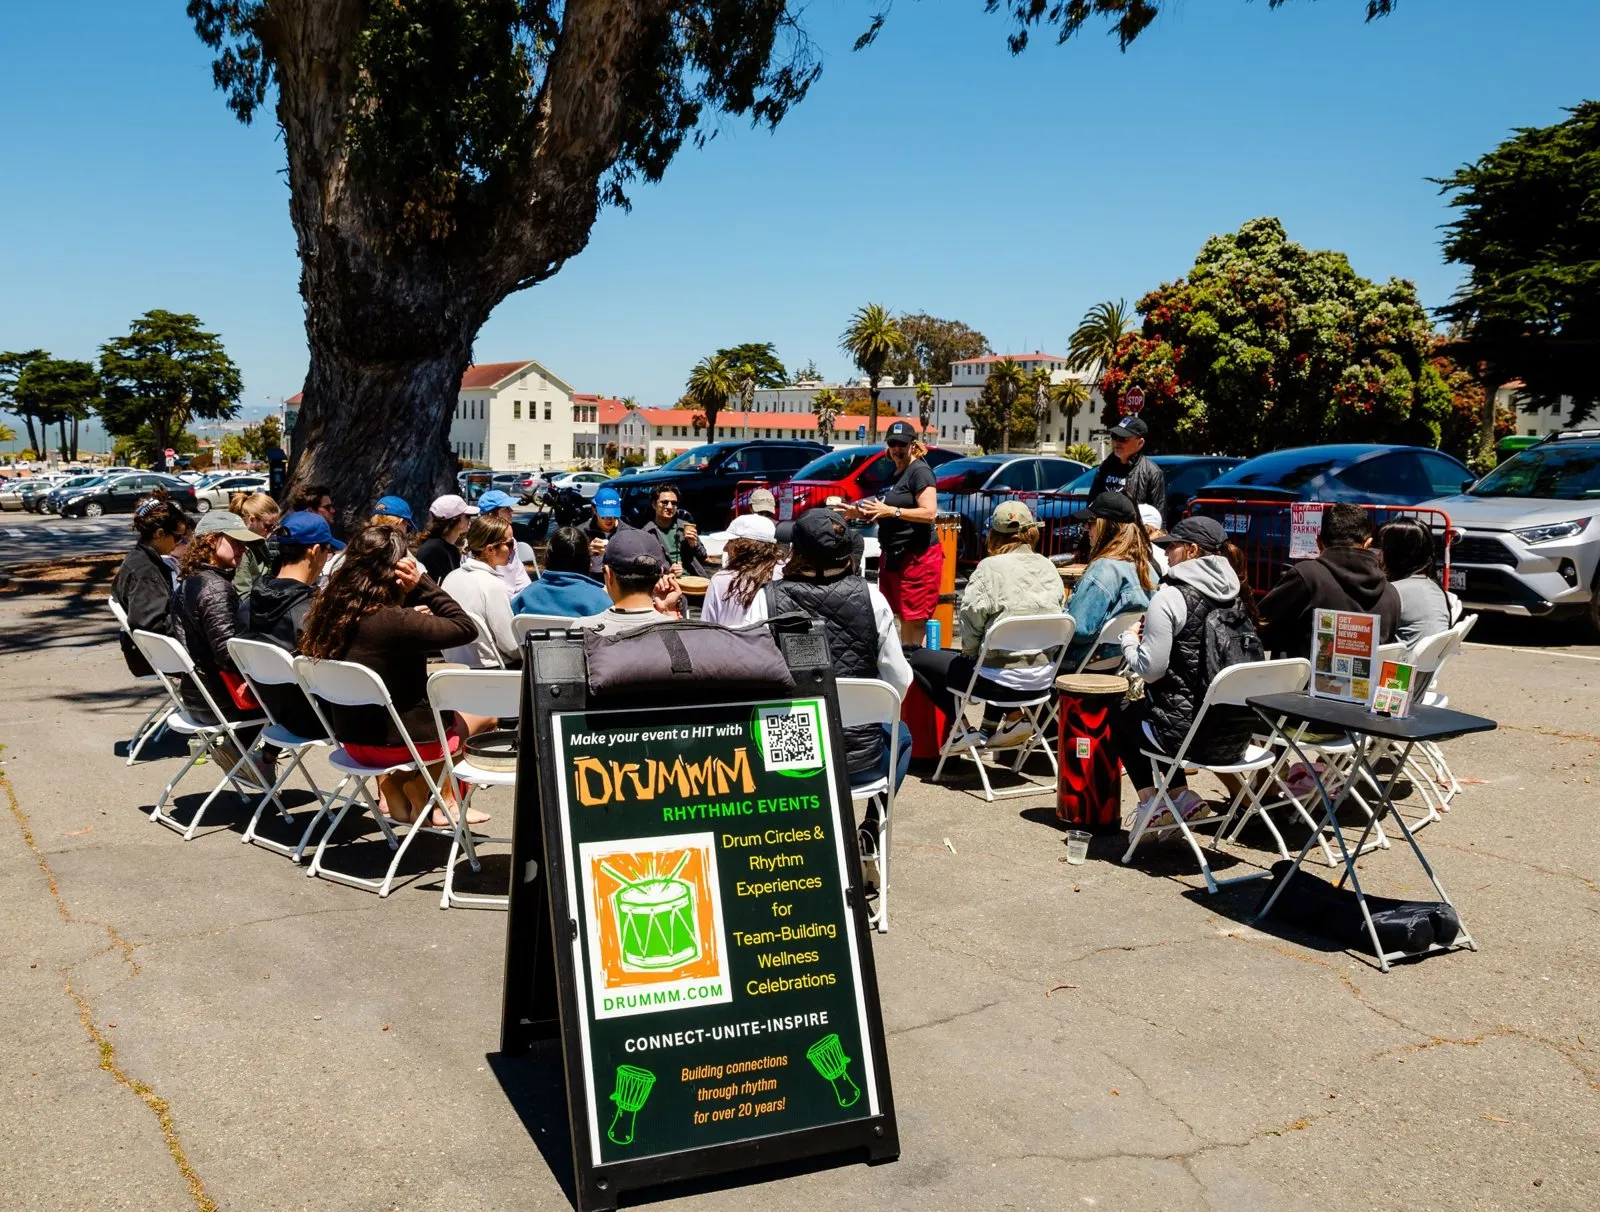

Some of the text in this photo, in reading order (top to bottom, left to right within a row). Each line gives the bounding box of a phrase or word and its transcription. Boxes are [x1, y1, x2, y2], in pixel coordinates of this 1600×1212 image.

[1128, 396, 1142, 405] STOP
[1293, 512, 1304, 524] NO
[1293, 525, 1320, 535] PARKING
[1338, 616, 1352, 624] GET
[1338, 630, 1358, 638] NEWS
[570, 723, 743, 747] Make your event a HIT with
[663, 795, 820, 822] RHYTHMIC EVENTS
[722, 826, 825, 849] Drum Circles &
[749, 853, 804, 872] Rhythm
[736, 876, 822, 898] Experiences
[771, 902, 792, 917] for
[733, 923, 836, 946] Team-Building
[757, 951, 819, 968] Wellness
[746, 973, 836, 996] Celebrations
[604, 984, 723, 1011] DRUMMM.COM
[624, 1011, 829, 1052] CONNECT-UNITE-INSPIRE
[681, 1055, 788, 1082] Building connections
[697, 1078, 777, 1102] through rhythm
[694, 1097, 786, 1125] for over 20 years!
